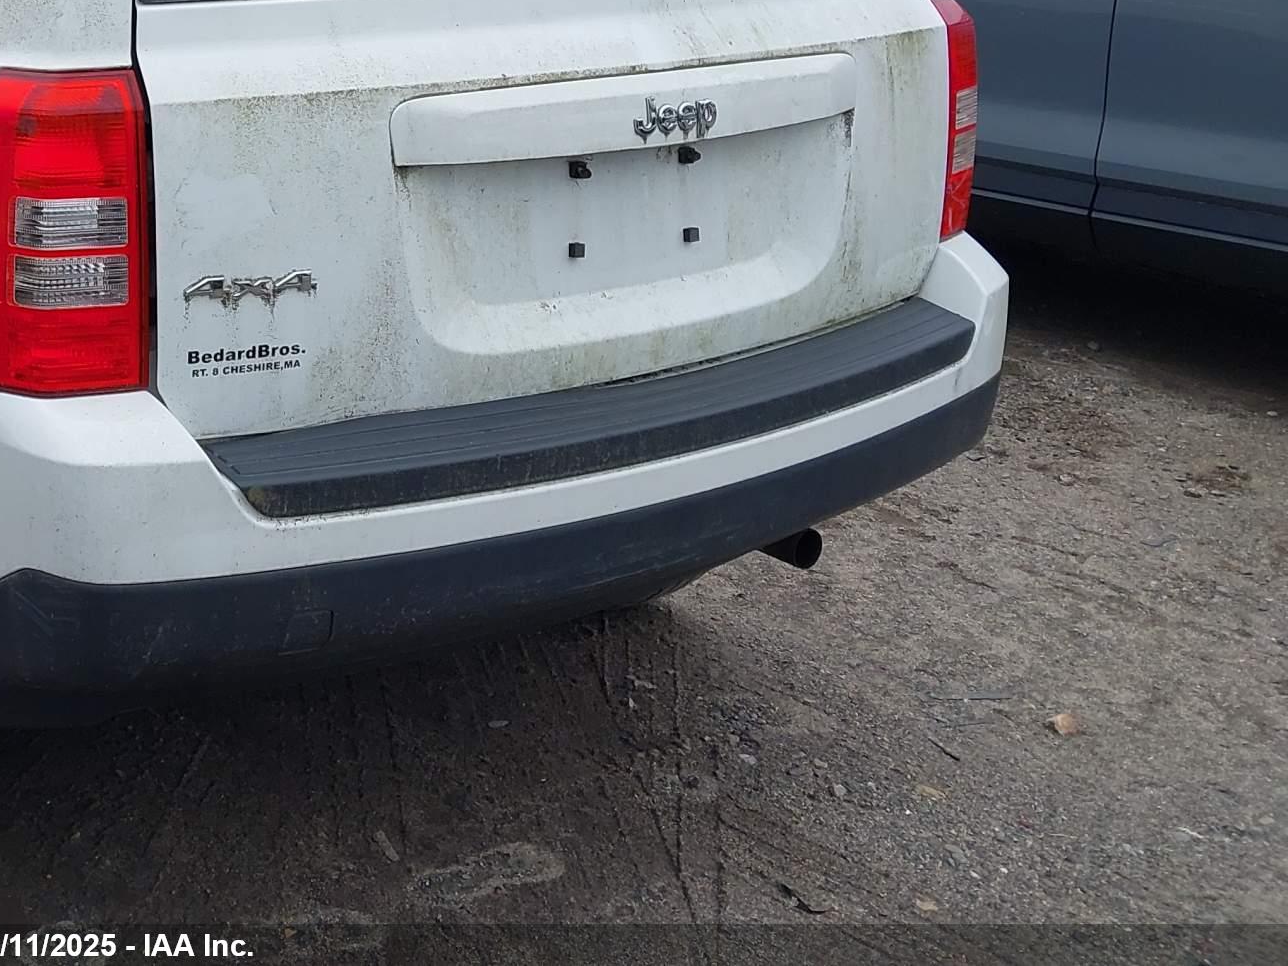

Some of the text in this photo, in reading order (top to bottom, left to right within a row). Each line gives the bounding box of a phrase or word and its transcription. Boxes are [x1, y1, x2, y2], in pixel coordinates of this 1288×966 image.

[633, 96, 718, 139] Jeep
[191, 359, 301, 378] RT. 8 CHESHIRE,MA
